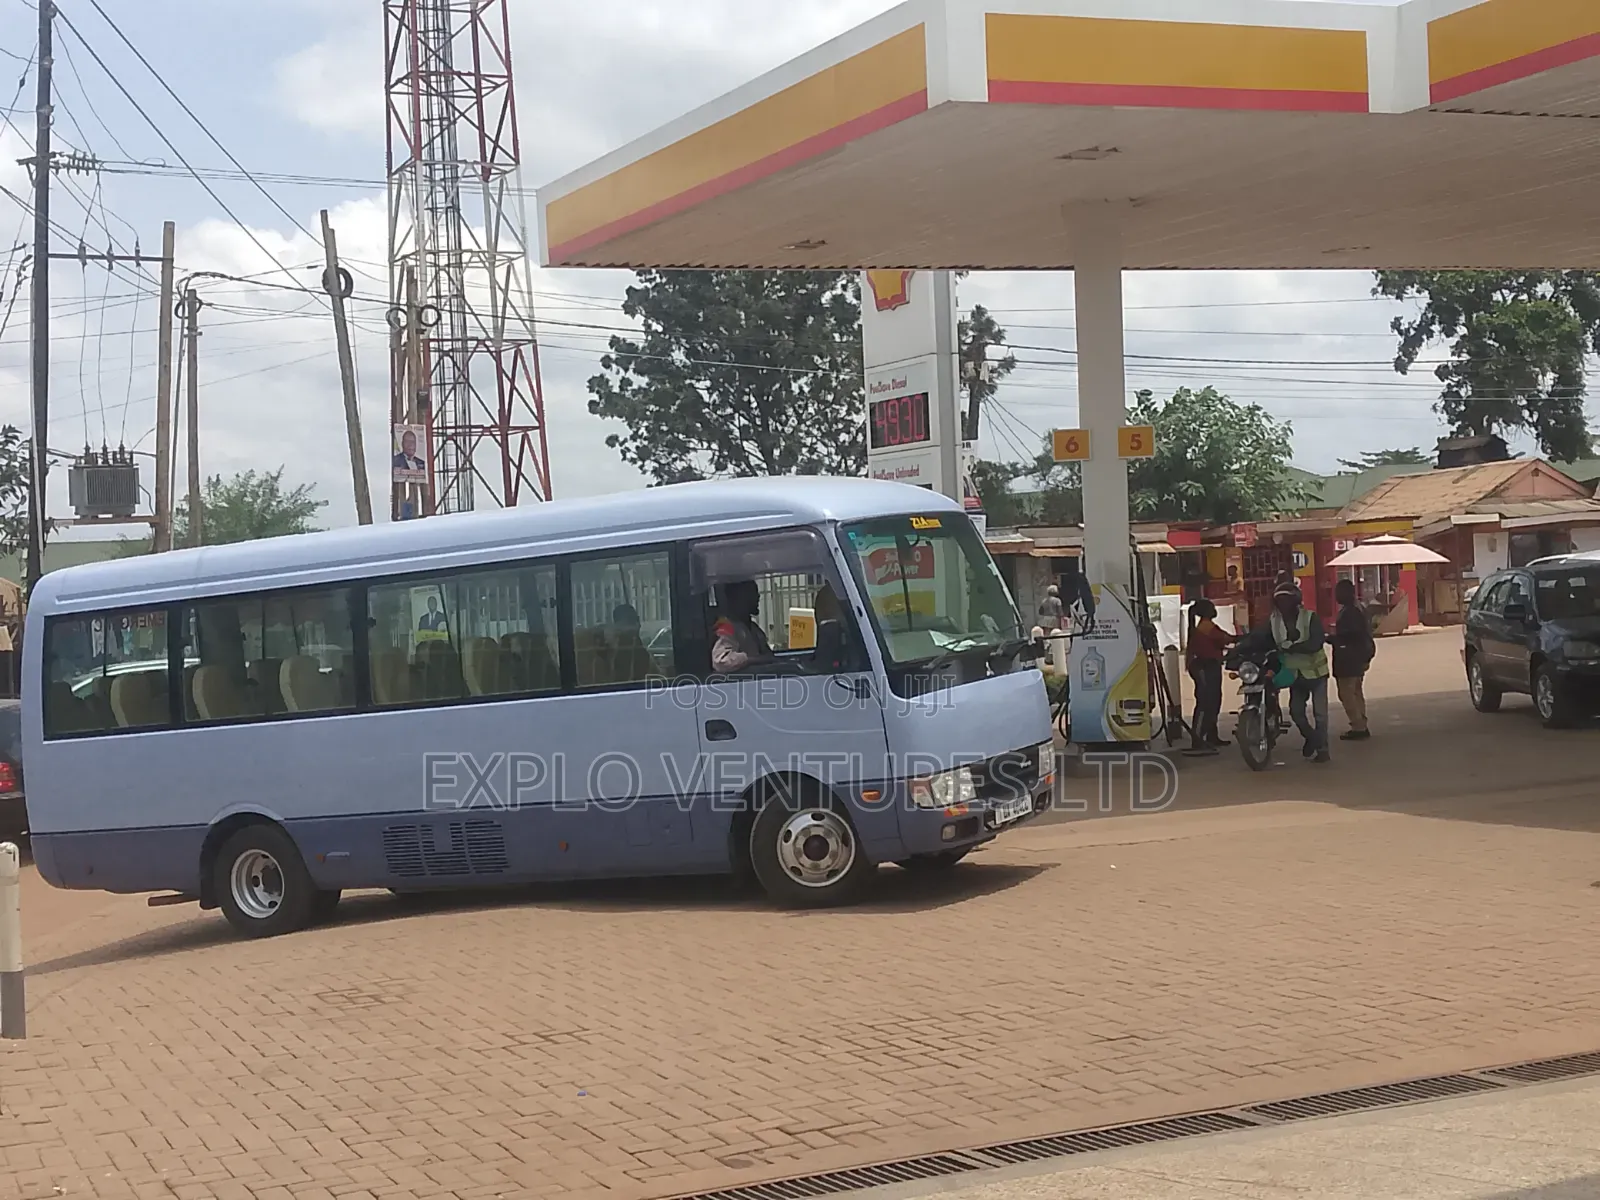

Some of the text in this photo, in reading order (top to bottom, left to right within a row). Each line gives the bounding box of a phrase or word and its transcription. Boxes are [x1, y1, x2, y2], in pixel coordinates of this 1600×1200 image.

[875, 393, 925, 445] 4930
[1065, 436, 1079, 454] 6
[1129, 433, 1142, 451] 5
[1292, 552, 1305, 567] TN
